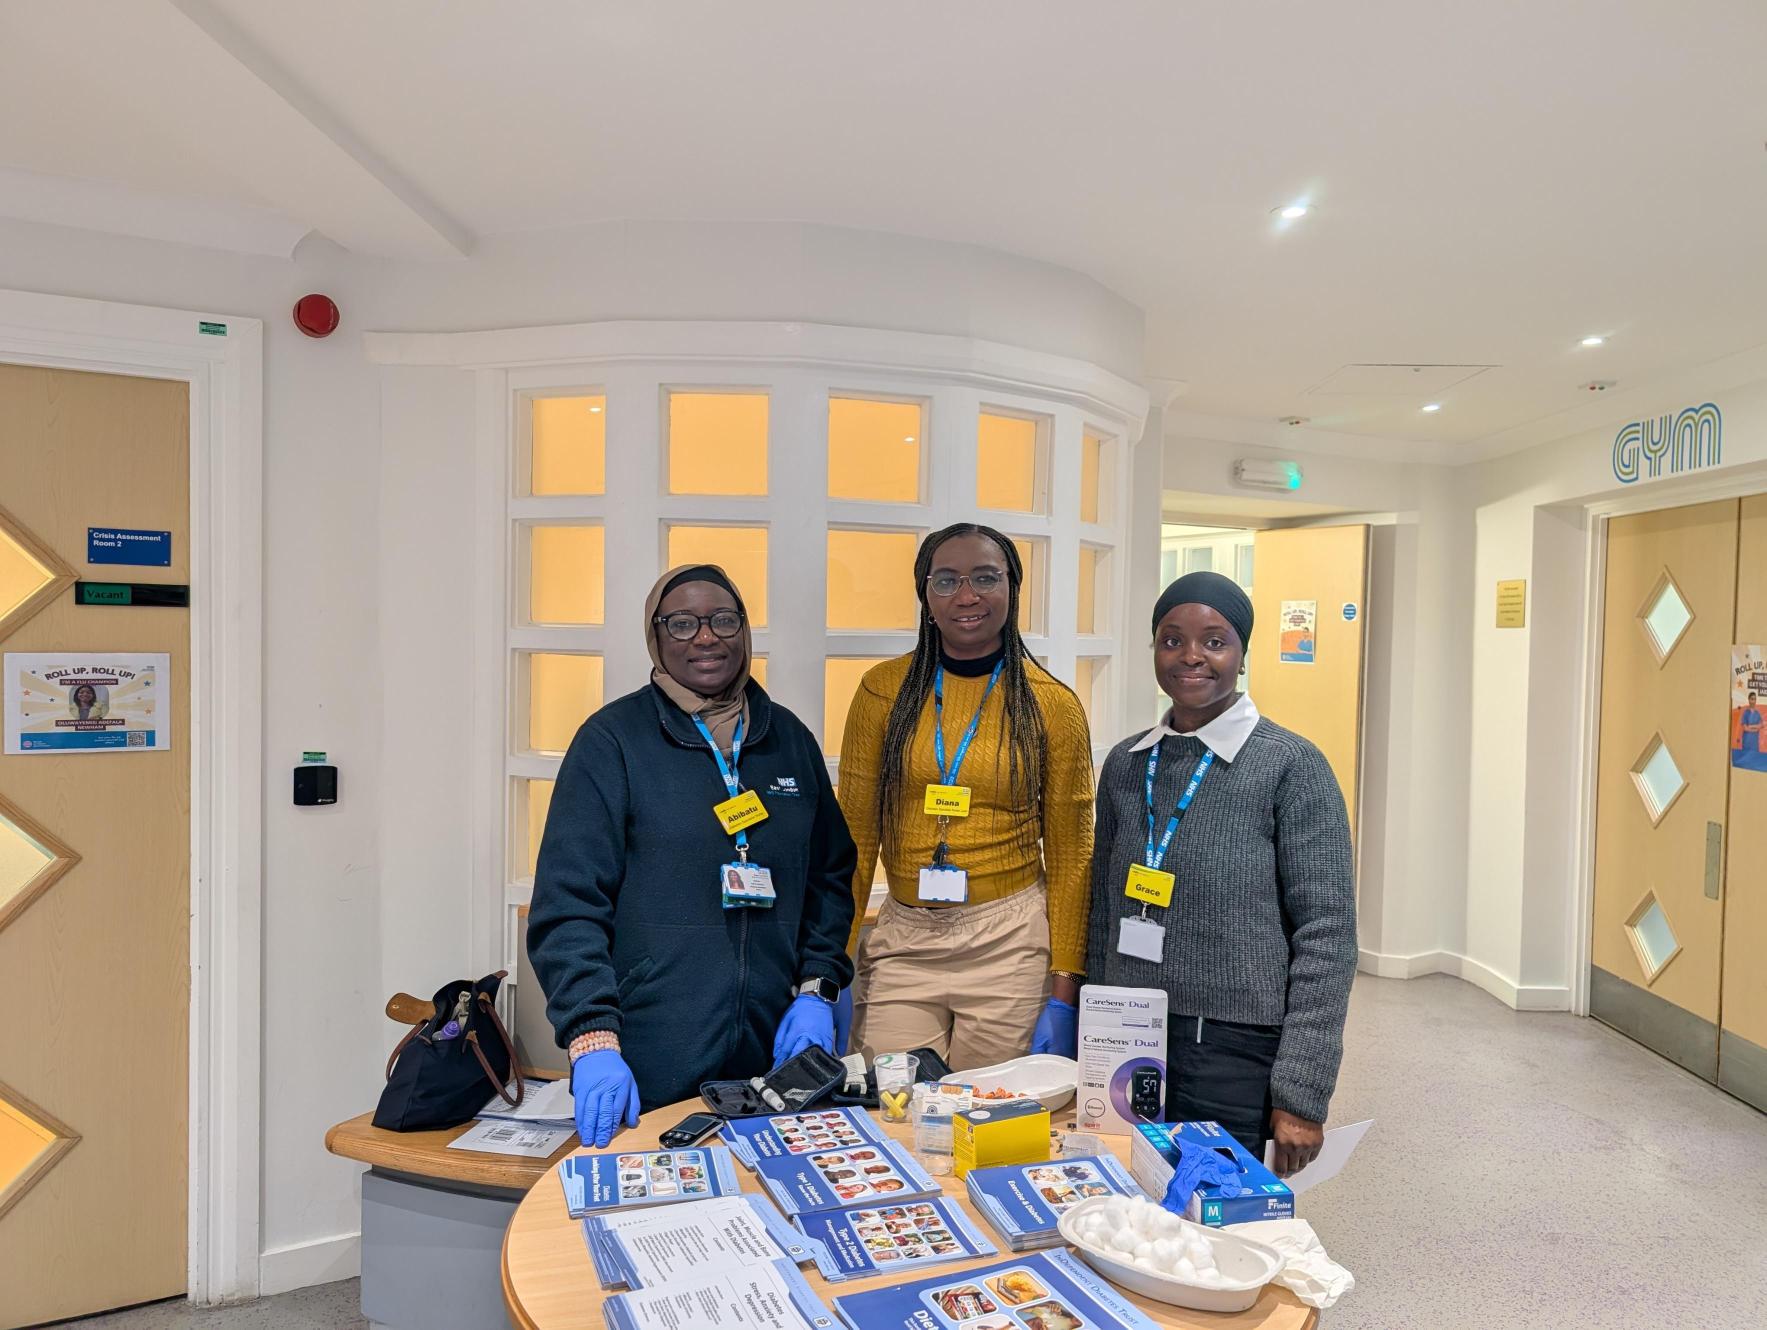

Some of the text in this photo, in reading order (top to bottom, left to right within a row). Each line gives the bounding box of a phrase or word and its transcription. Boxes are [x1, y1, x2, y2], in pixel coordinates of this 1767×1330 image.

[1613, 402, 1721, 483] GYM
[116, 532, 160, 542] Assessment
[87, 590, 124, 600] Vacant
[45, 670, 70, 680] ROLL
[92, 667, 116, 676] ROLL
[118, 670, 136, 680] UP!
[1735, 663, 1752, 676] ROLL
[1148, 761, 1156, 776] NHS
[1196, 762, 1208, 777] NHS
[777, 777, 795, 786] NHS
[1186, 780, 1197, 797] NHS
[728, 806, 758, 823] Abibatu
[1162, 830, 1172, 847] NHS
[1153, 852, 1163, 868] NHS
[1136, 884, 1160, 896] Grace
[1086, 998, 1124, 1007] CareSens
[1084, 1035, 1129, 1045] CareSens
[1143, 1079, 1157, 1093] 57
[761, 1130, 783, 1156] Understanding
[591, 1157, 600, 1173] Looking
[796, 1172, 810, 1183] Type
[807, 1186, 824, 1205] Diabetes
[1007, 1179, 1027, 1201] Exercise
[1025, 1204, 1045, 1225] Diabetes
[1208, 1206, 1218, 1216] M
[712, 1237, 725, 1252] Contents
[723, 1227, 746, 1255] With Diabetes
[727, 1218, 761, 1258] Problems Associated
[743, 1226, 757, 1240] Muscle
[753, 1238, 764, 1248] and
[760, 1247, 771, 1258] Bone
[825, 1219, 841, 1243] Management
[840, 1250, 854, 1268] Medication
[838, 1228, 851, 1242] Type
[848, 1246, 865, 1267] Diabetes
[744, 1294, 766, 1324] Depression
[749, 1282, 783, 1329] Stress, Anxiety and
[767, 1292, 785, 1315] Diabetes
[730, 1303, 745, 1322] Contents
